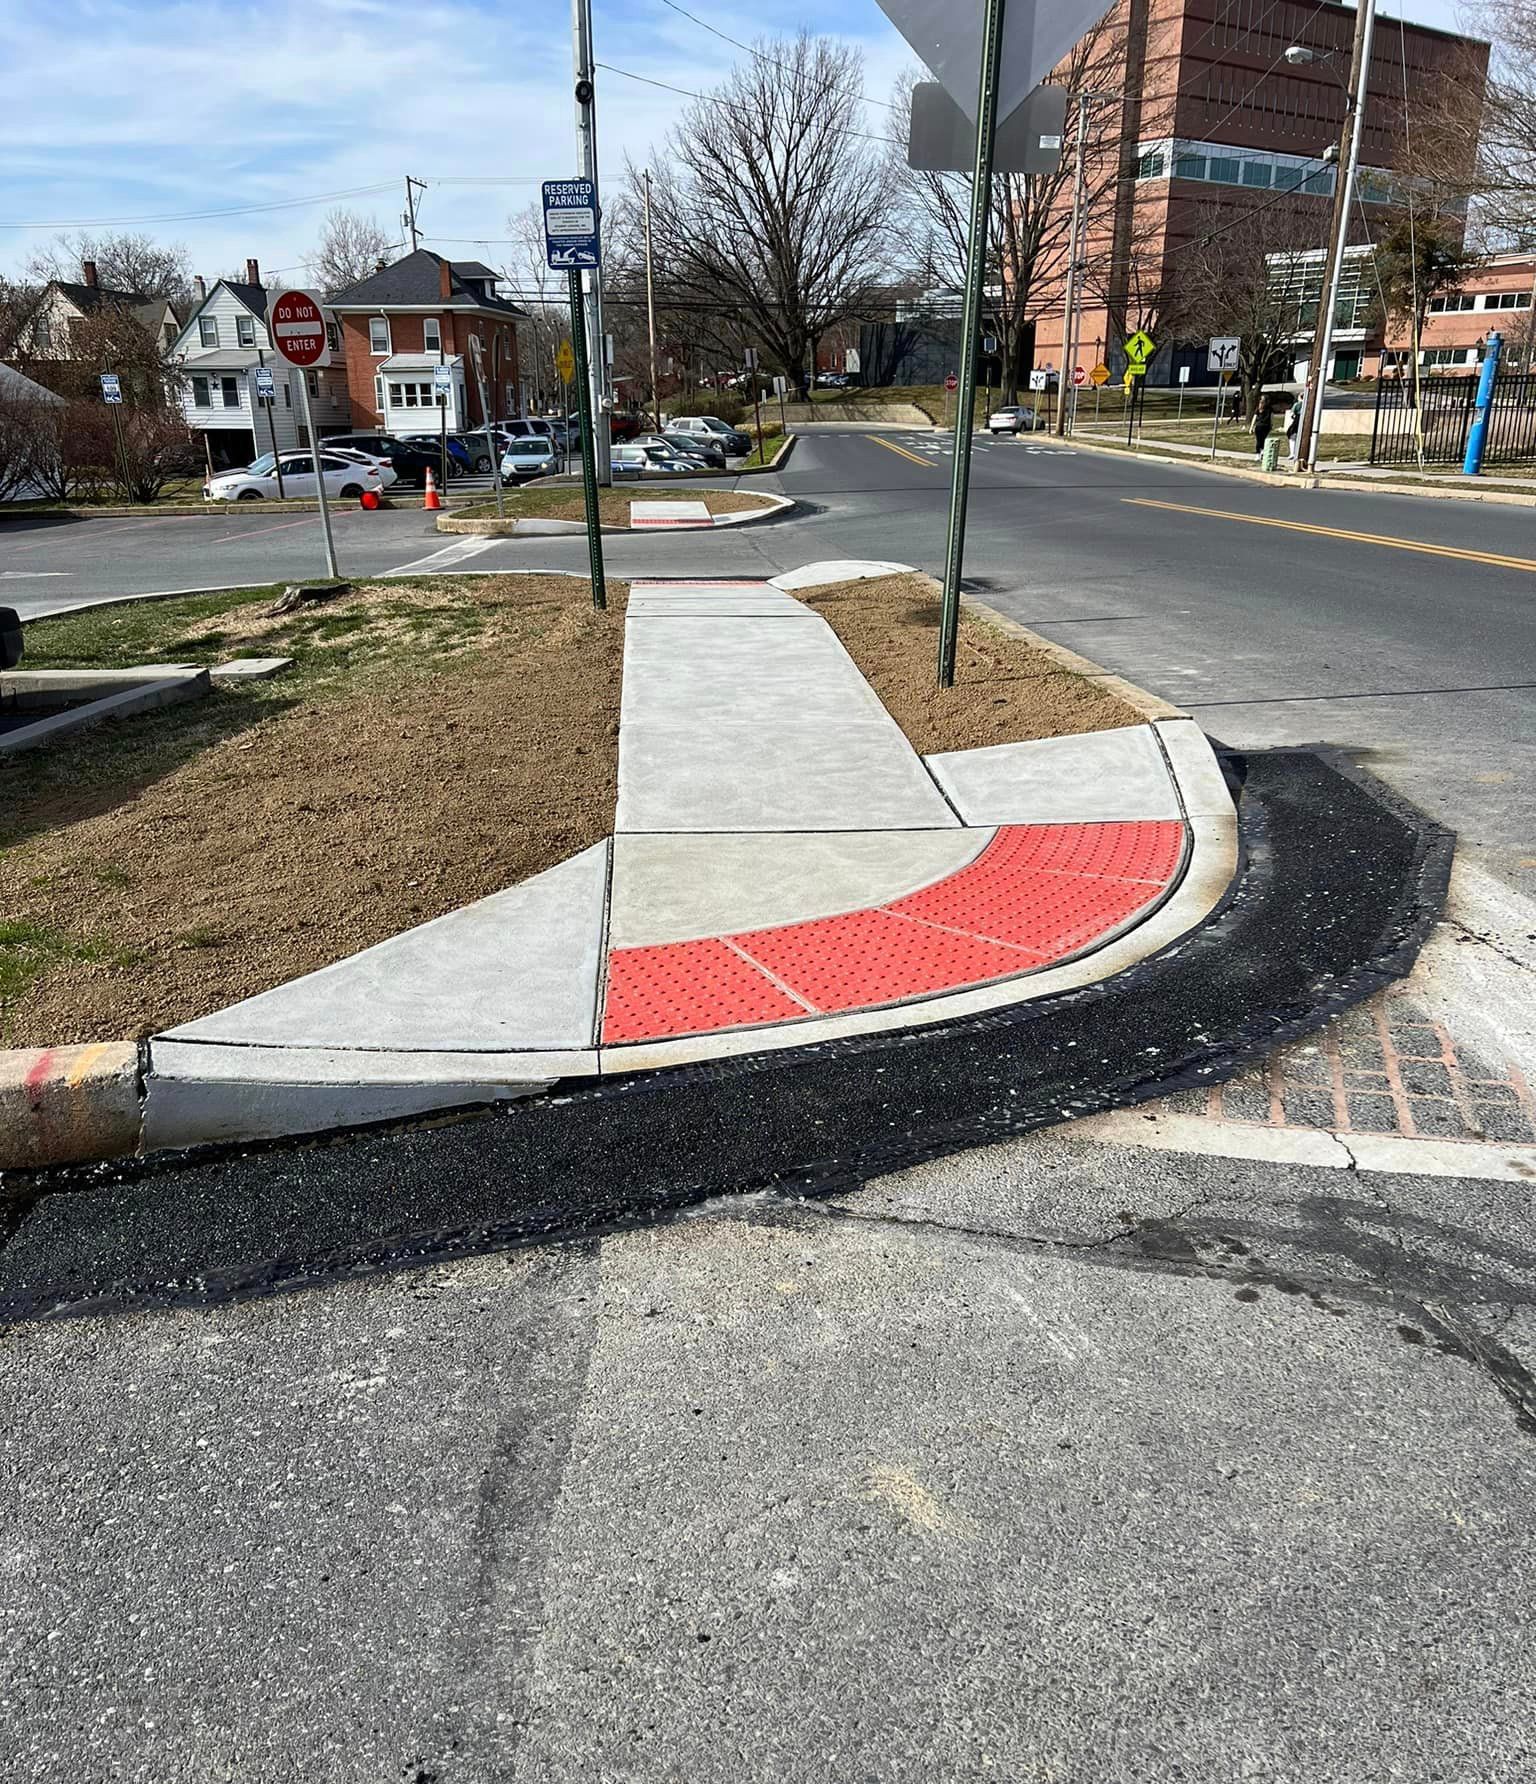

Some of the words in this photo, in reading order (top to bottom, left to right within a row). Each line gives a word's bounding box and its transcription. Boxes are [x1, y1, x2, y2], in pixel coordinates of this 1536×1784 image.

[544, 184, 592, 195] RESERVED
[549, 195, 589, 206] PARKING
[279, 307, 291, 319] DO
[296, 306, 313, 318] NOT
[287, 339, 316, 351] ENTER
[1072, 371, 1085, 380] TOP
